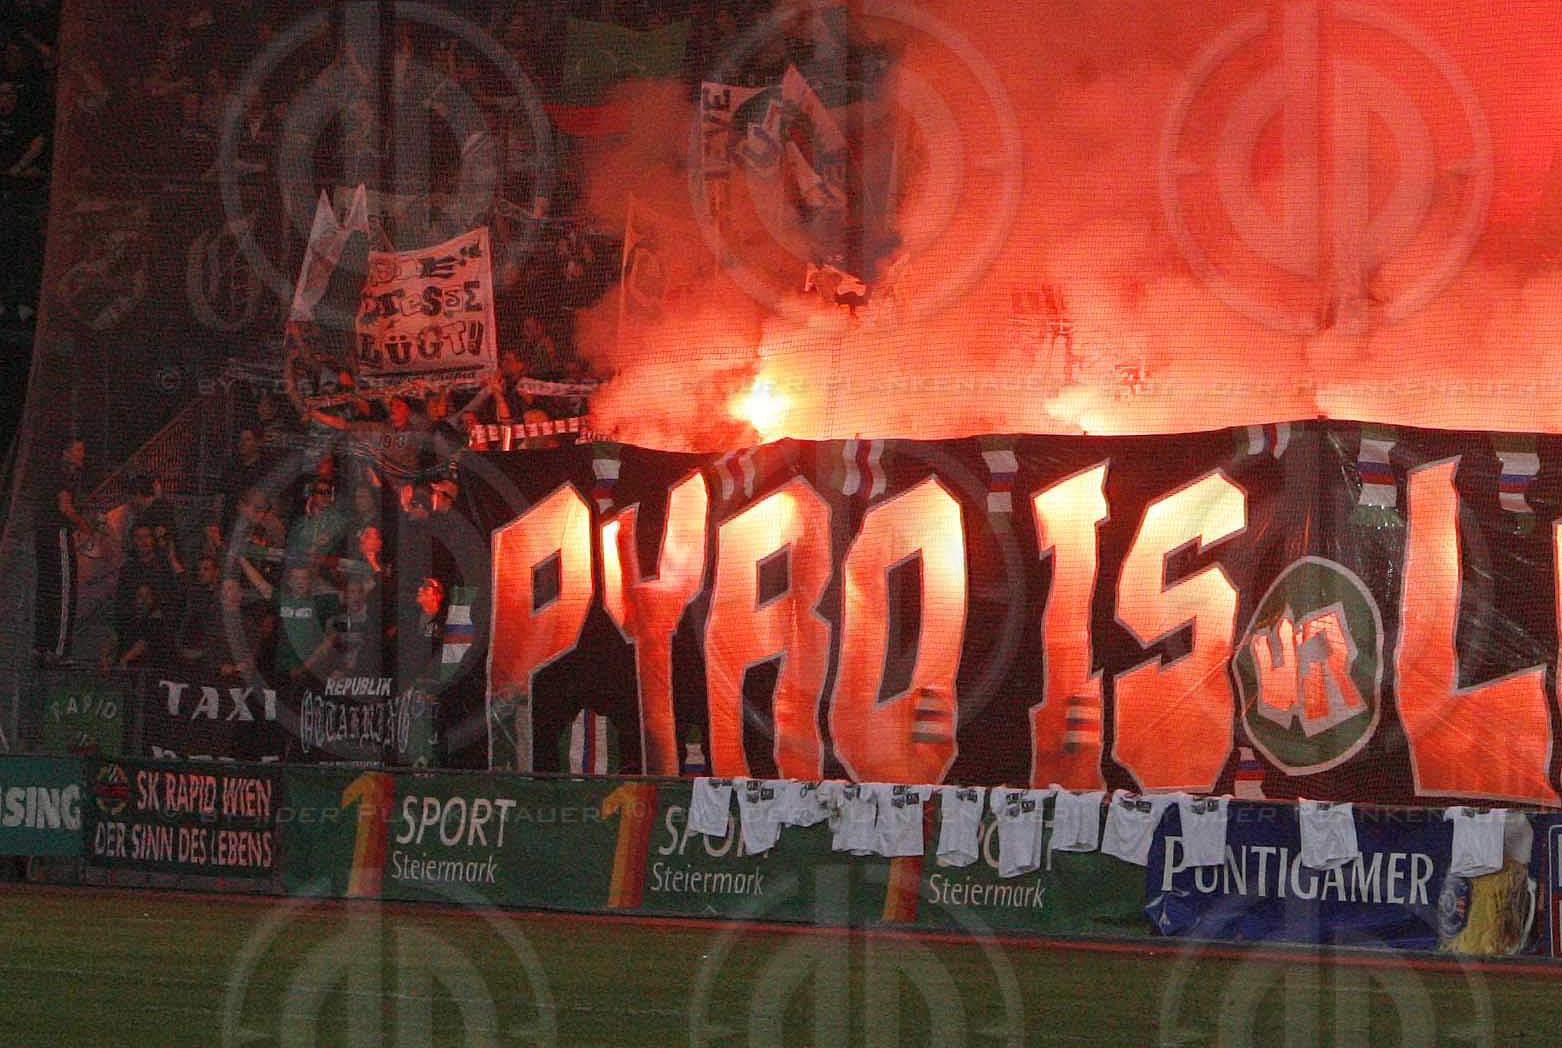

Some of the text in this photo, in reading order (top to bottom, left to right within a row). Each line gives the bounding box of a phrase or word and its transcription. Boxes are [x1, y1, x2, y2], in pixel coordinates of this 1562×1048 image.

[486, 468, 970, 787] PYRO
[1027, 458, 1248, 795] IS
[160, 679, 278, 721] TAXI
[324, 677, 392, 697] REPUBLIK
[136, 770, 273, 818] SK RAPID WIEN
[94, 821, 273, 869] DER SINN DES LEBENS
[396, 797, 517, 849] SPORT
[391, 853, 498, 885] Steiermark
[650, 862, 765, 897] Steiermark
[1161, 835, 1434, 906] PUNTIGAMER
[928, 874, 1047, 910] Steiermark
